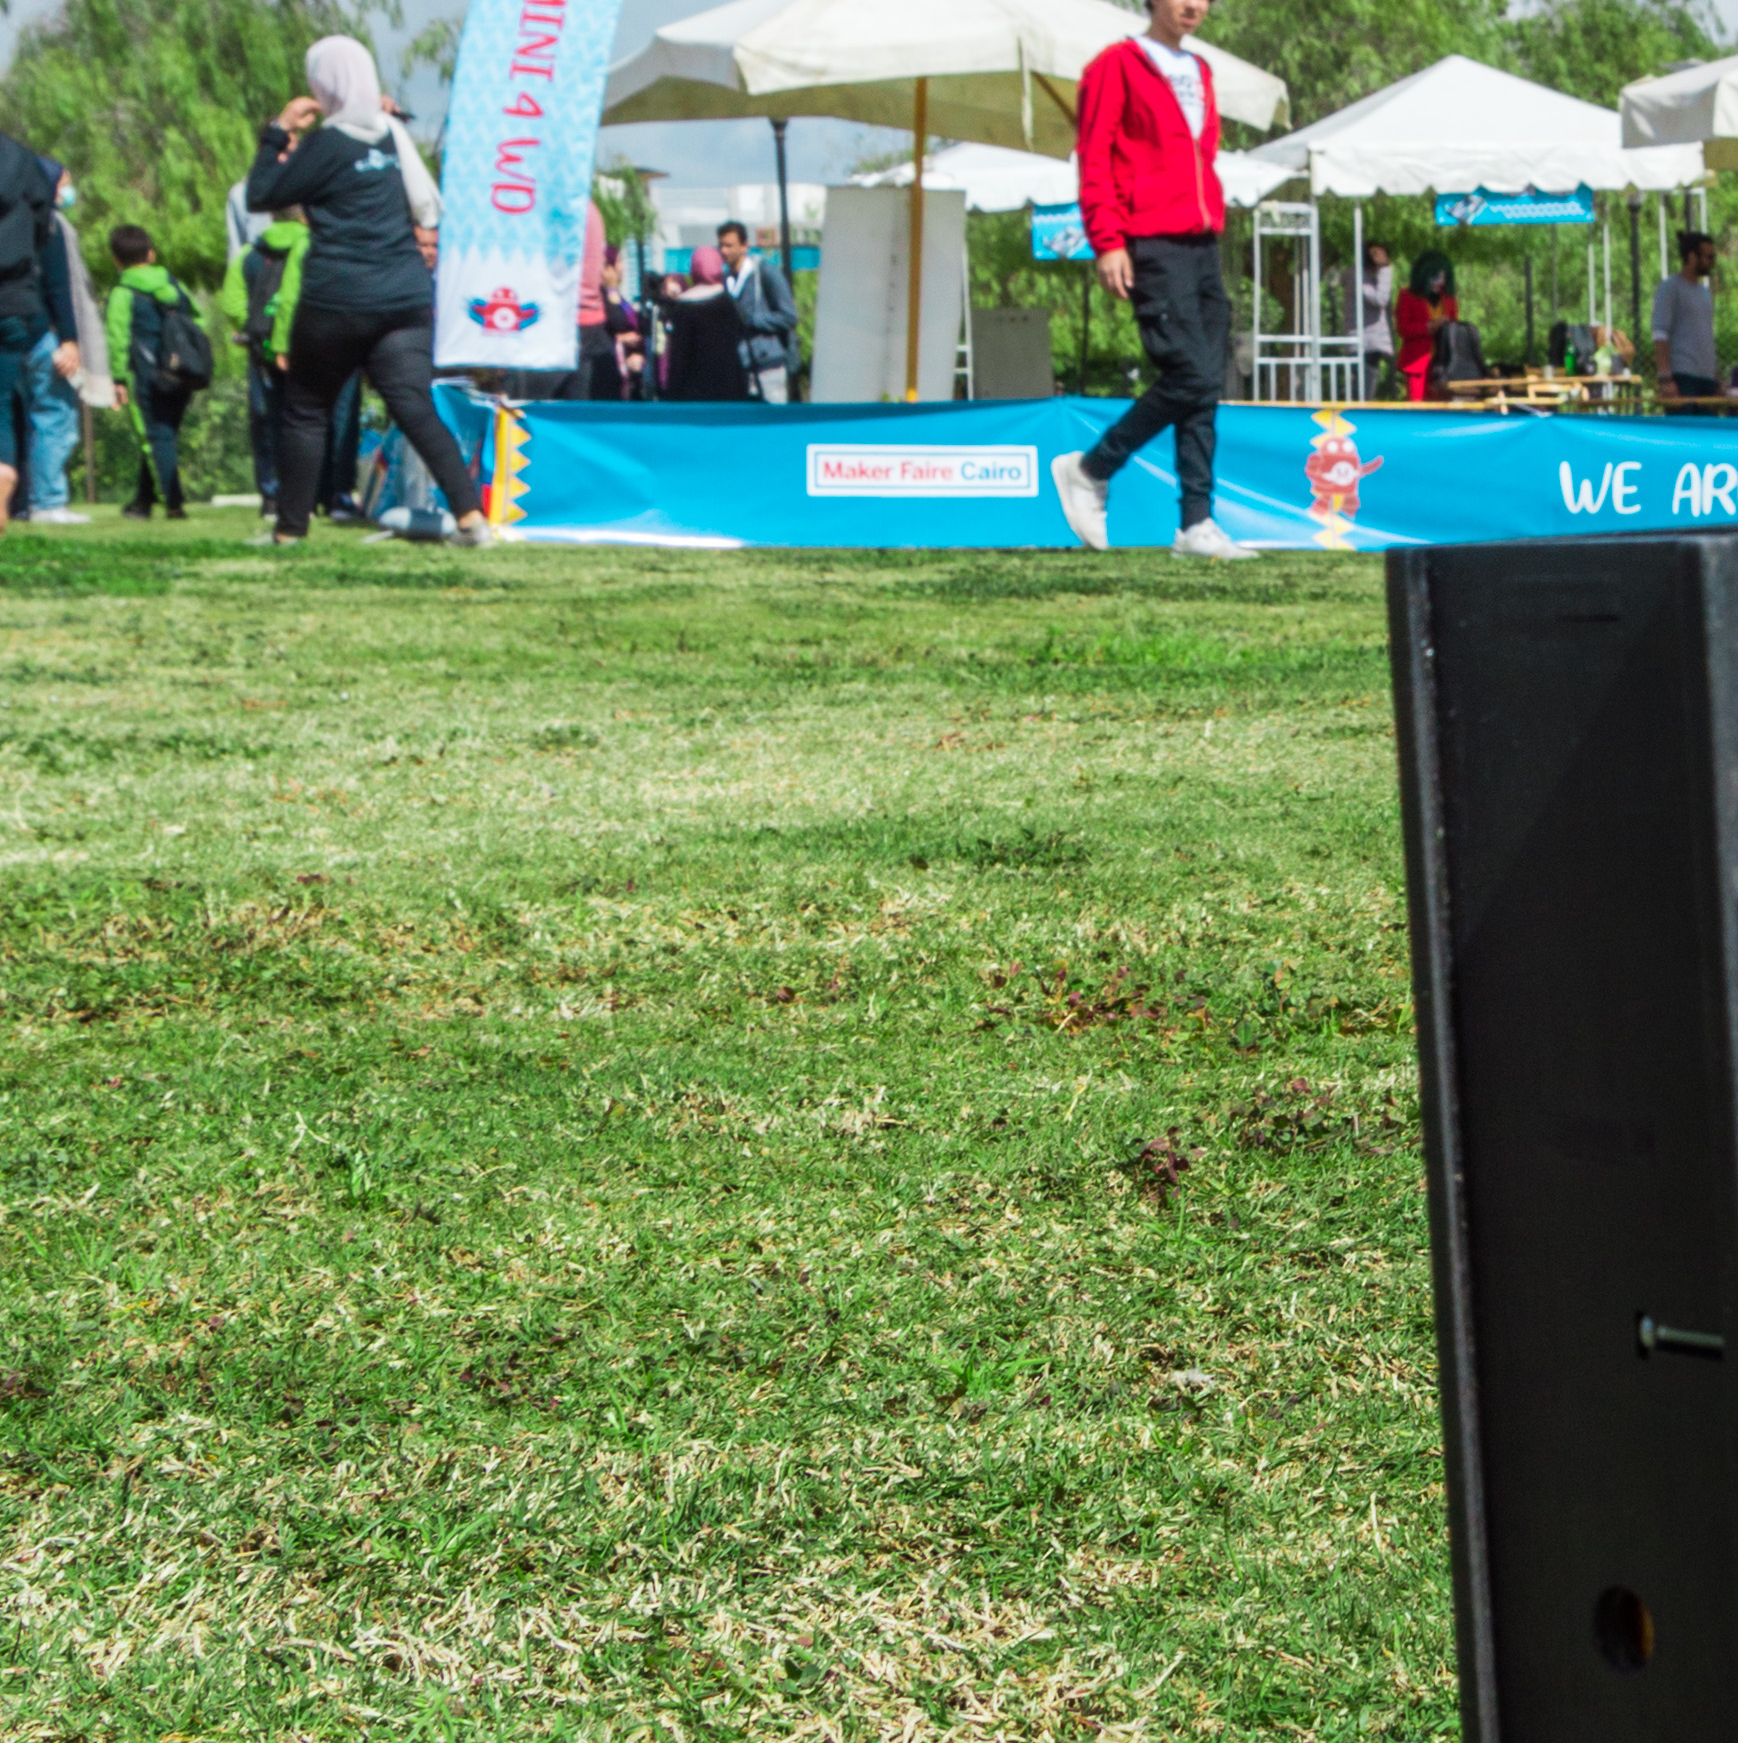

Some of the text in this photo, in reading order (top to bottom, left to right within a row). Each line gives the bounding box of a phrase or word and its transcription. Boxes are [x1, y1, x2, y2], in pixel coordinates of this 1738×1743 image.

[501, 91, 545, 119] 4
[491, 137, 542, 215] WD
[823, 461, 1022, 481] Maker Faire Cairo
[1559, 460, 1642, 515] WE
